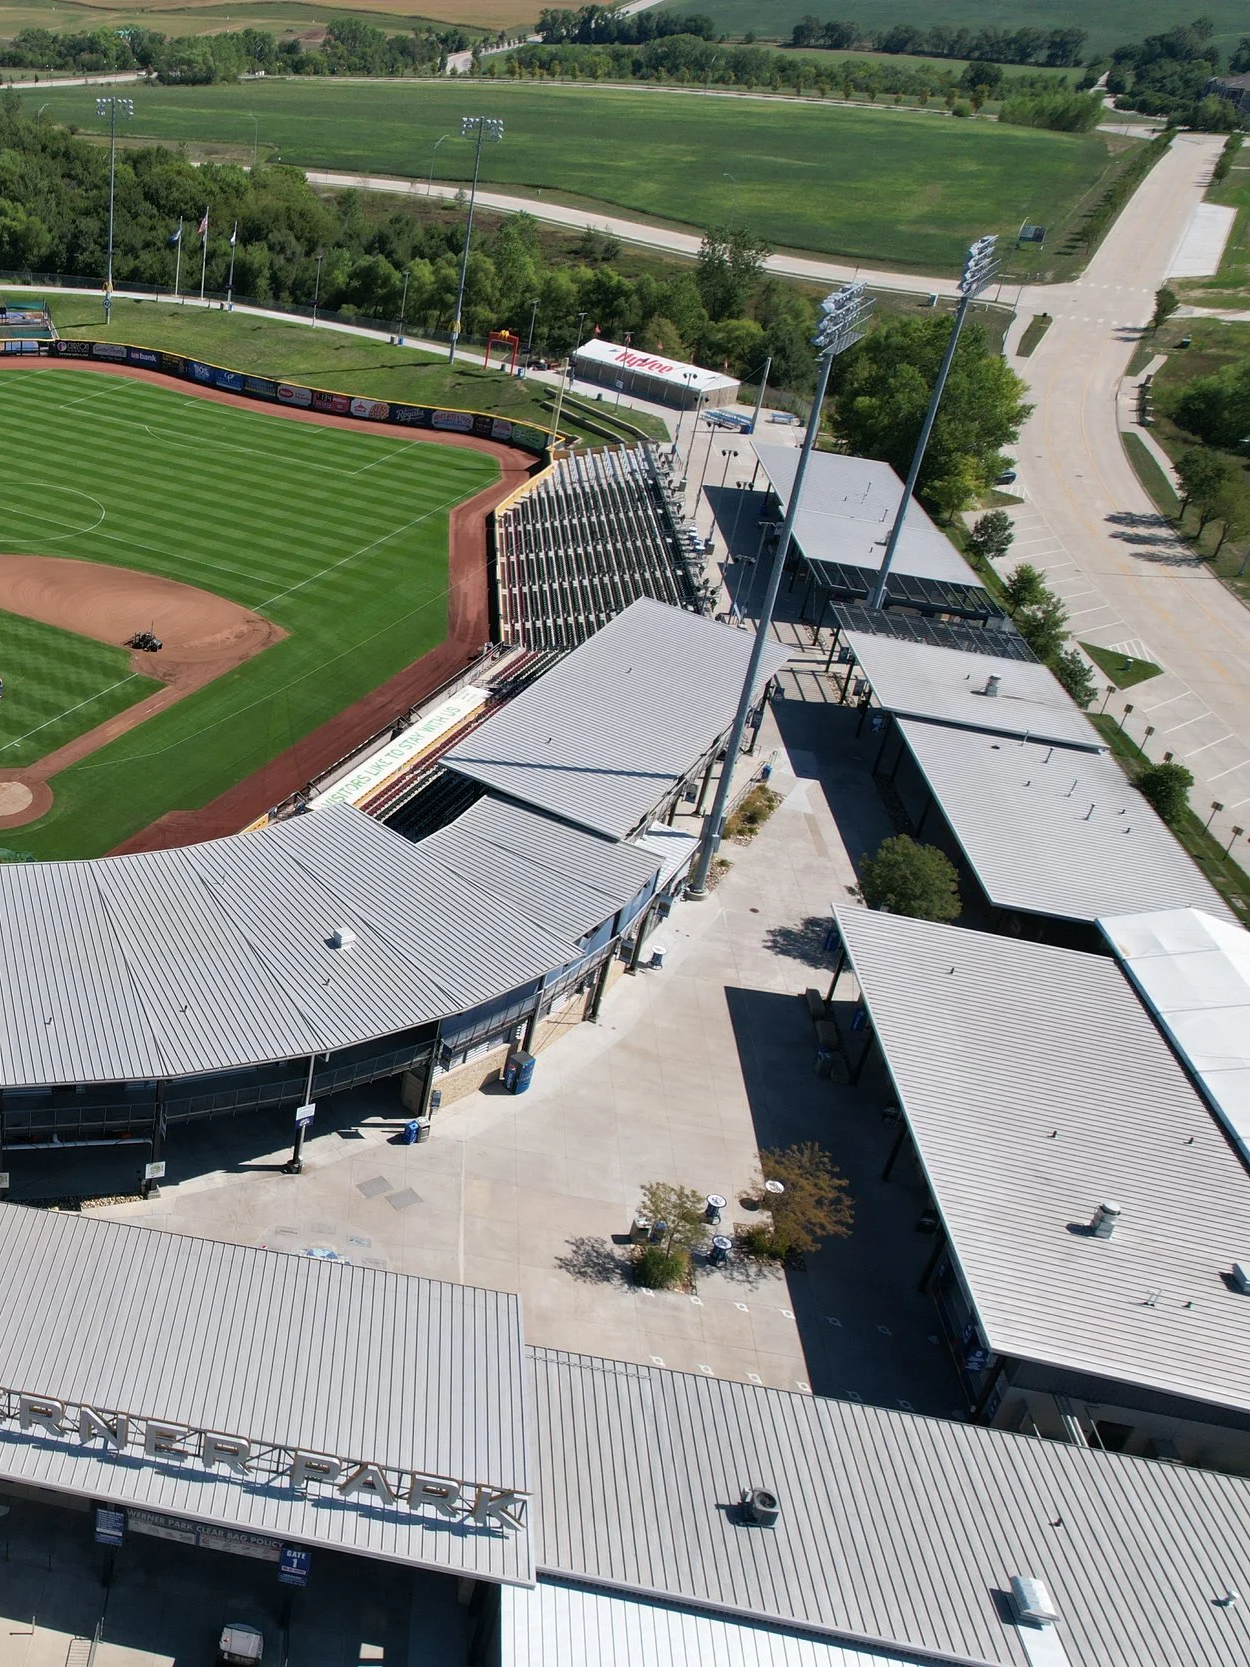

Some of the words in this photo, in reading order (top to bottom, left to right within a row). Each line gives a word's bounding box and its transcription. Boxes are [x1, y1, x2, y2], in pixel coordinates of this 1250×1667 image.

[139, 352, 157, 362] bank
[322, 774, 371, 807] VISITORS
[366, 758, 390, 776] LIKE
[389, 746, 405, 759] TO
[398, 729, 426, 751] STAY
[422, 715, 447, 733] WITH
[447, 705, 461, 717] US
[291, 1446, 527, 1532] PARK
[126, 1509, 166, 1526] WERNER
[167, 1519, 194, 1532] PARK
[196, 1525, 225, 1537] CLEAR
[227, 1532, 248, 1542] BAG
[250, 1536, 284, 1548] POLICY
[286, 1550, 306, 1560] GATE
[291, 1558, 298, 1568] 1
